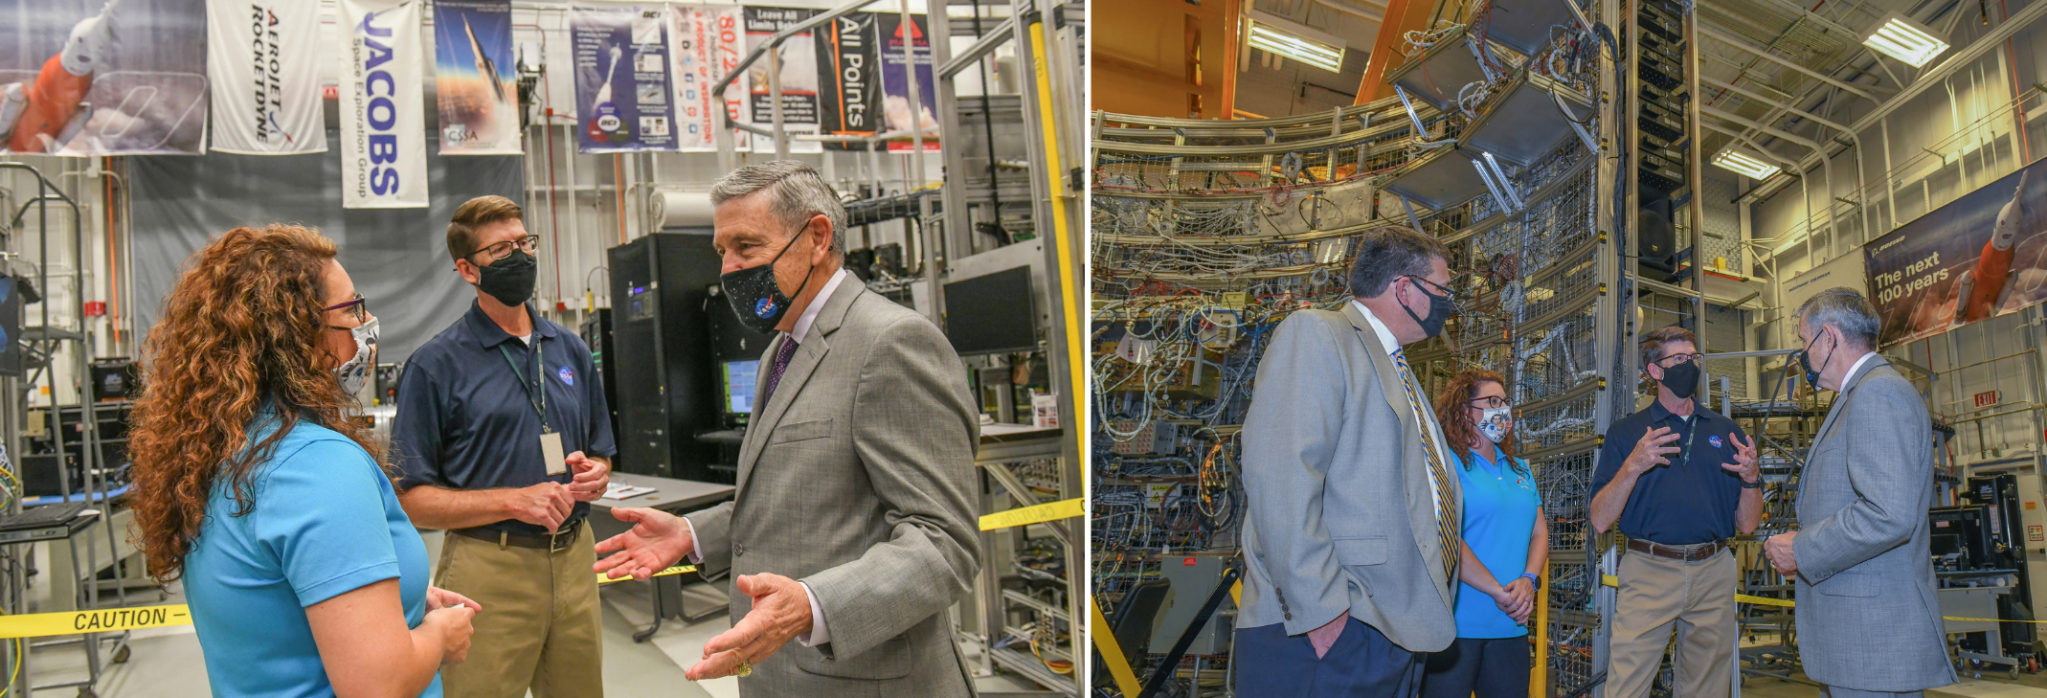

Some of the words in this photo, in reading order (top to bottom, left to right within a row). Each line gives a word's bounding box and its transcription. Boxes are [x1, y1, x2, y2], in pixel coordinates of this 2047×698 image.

[748, 19, 776, 31] Limits
[757, 9, 783, 20] Leave
[783, 10, 798, 21] All
[839, 16, 862, 47] All
[252, 4, 267, 143] ROCKETDYNE
[268, 6, 281, 111] AEROJET
[353, 38, 361, 77] Space
[363, 11, 399, 196] JACOBS
[843, 53, 866, 127] Points
[353, 81, 364, 154] Exploration
[357, 157, 367, 198] Group
[1875, 270, 1902, 289] The
[1905, 251, 1940, 278] next
[1878, 284, 1902, 305] 100
[1905, 268, 1949, 297] years
[1978, 392, 1994, 406] EXIT
[74, 608, 167, 630] CAUTION
